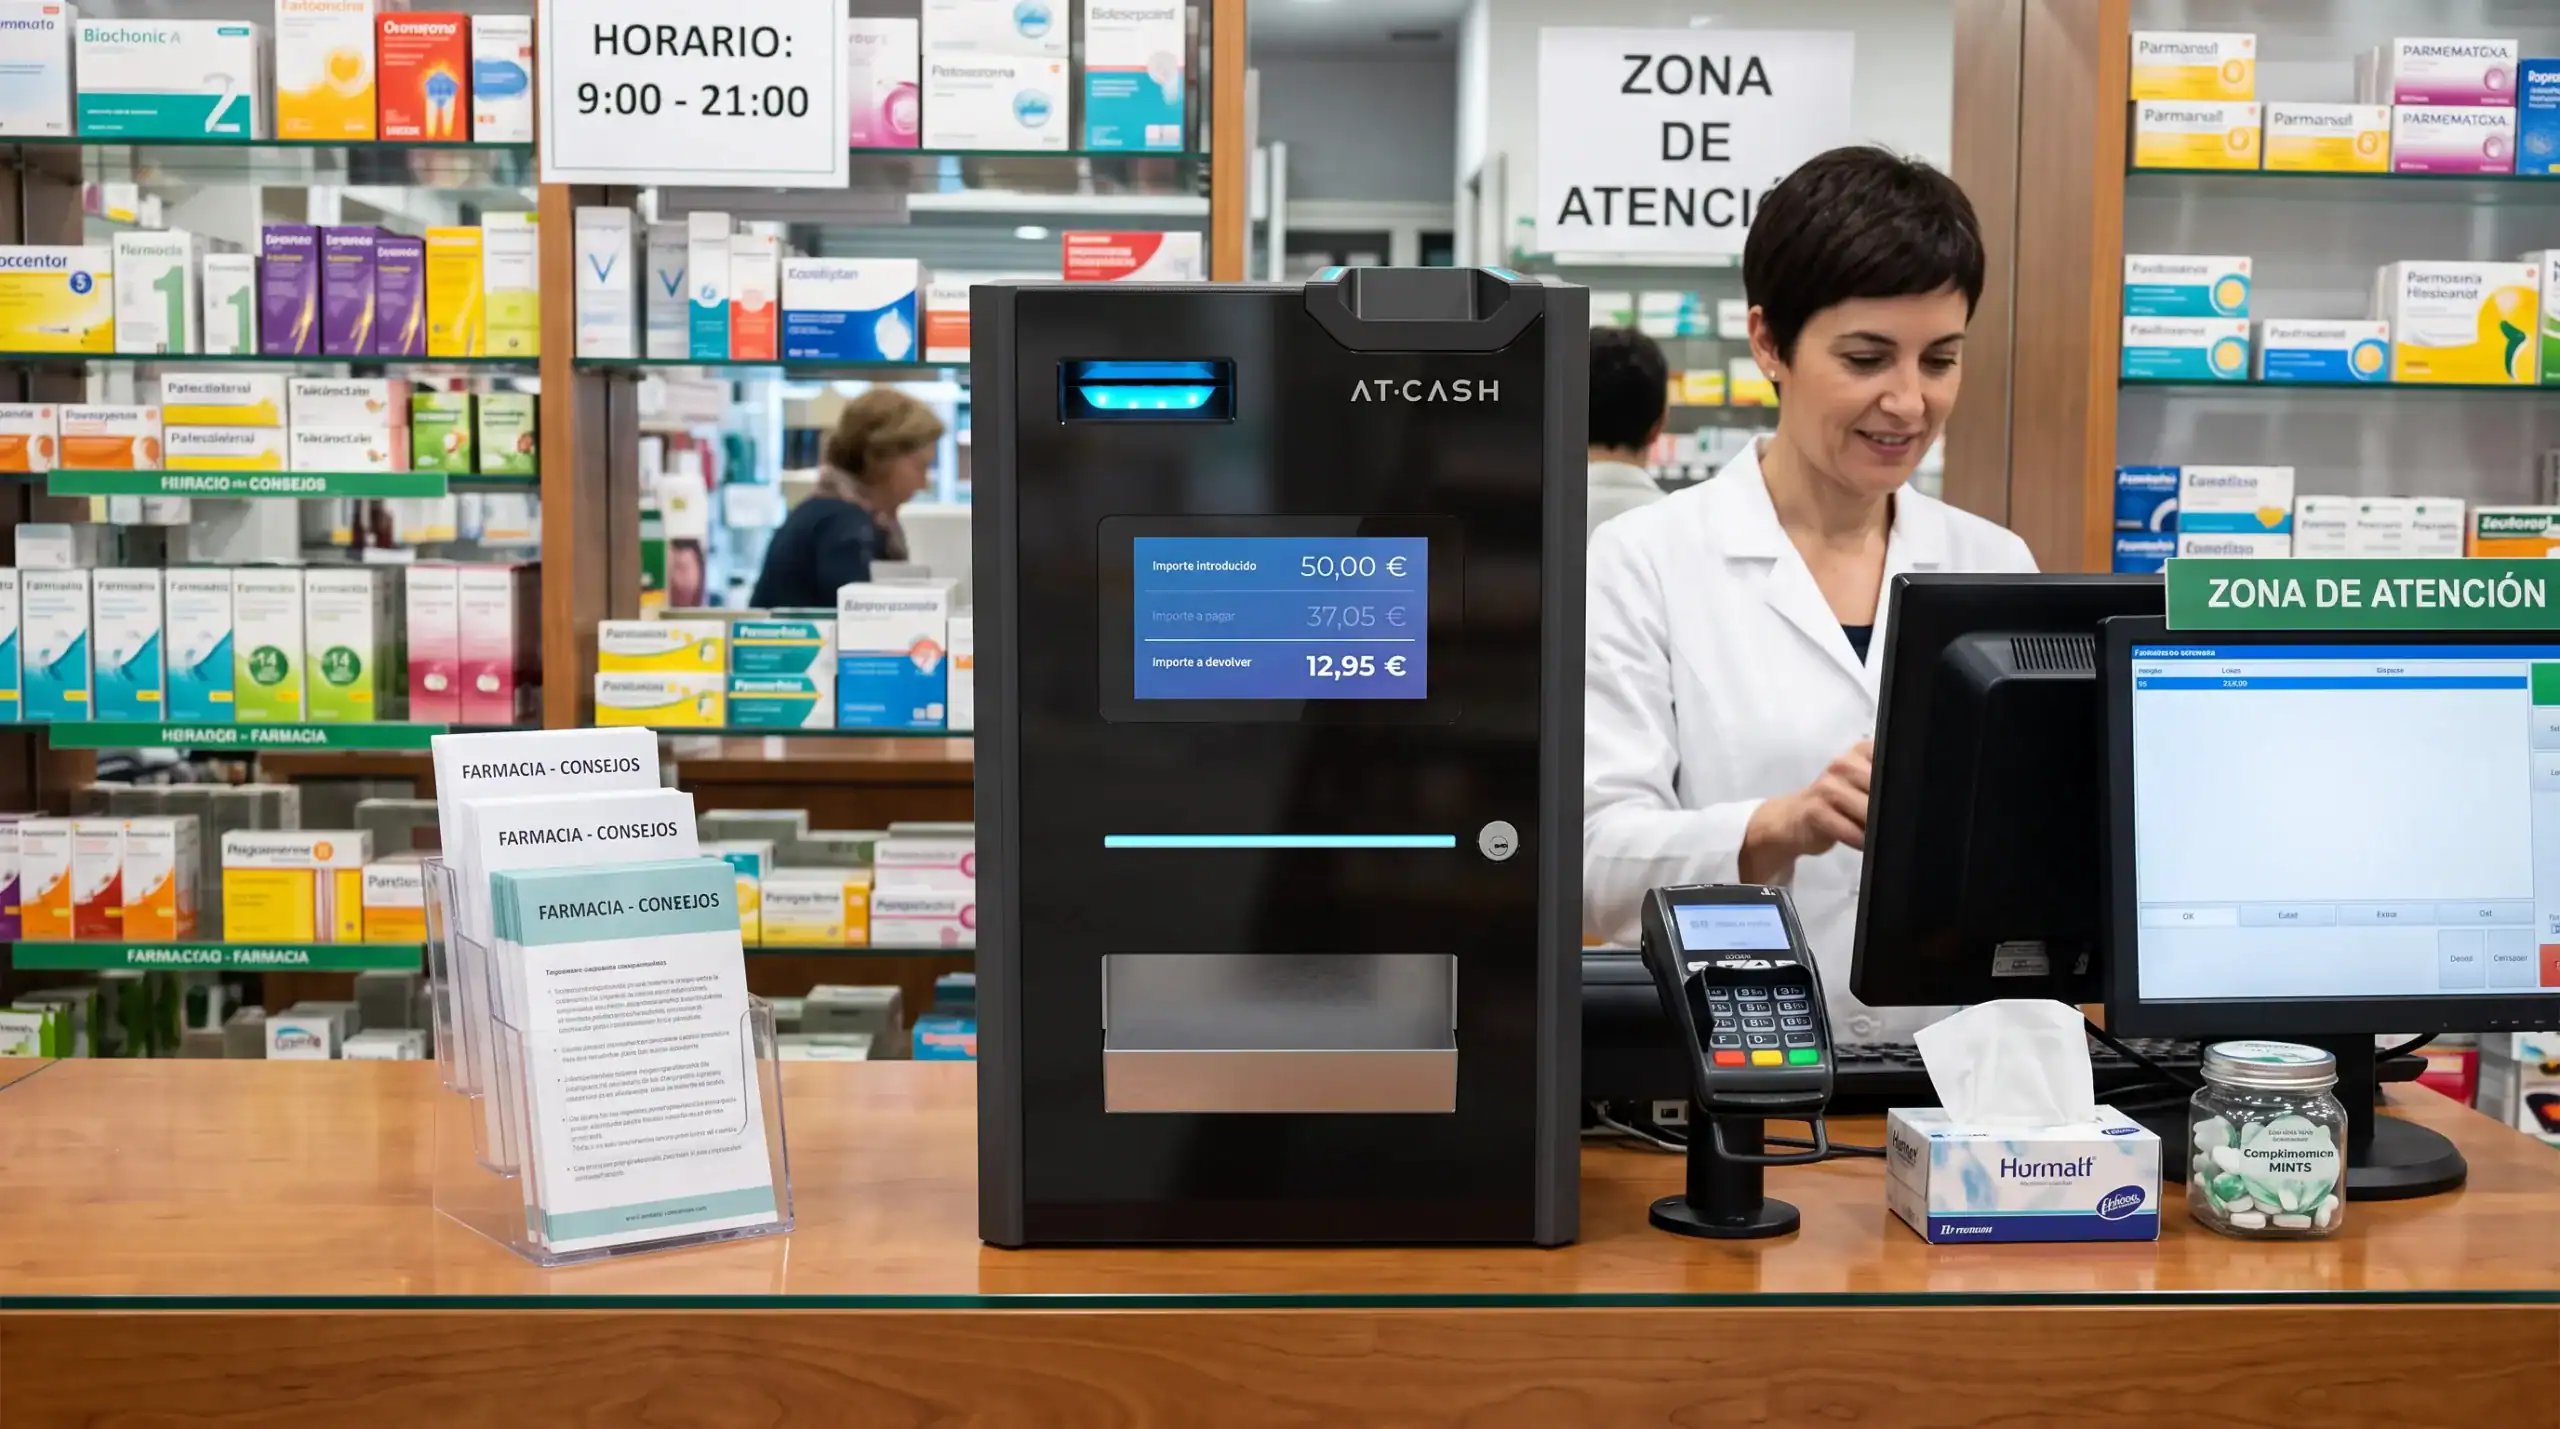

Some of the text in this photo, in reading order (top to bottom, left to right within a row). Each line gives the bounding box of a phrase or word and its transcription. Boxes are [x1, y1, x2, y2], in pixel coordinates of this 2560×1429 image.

[83, 28, 167, 44] Biochonic
[594, 24, 793, 58] HORARIO:
[1620, 54, 1774, 97] ZONA
[202, 71, 242, 133] 2
[577, 82, 810, 118] 9:00 - 21:00
[1661, 121, 1731, 162] DE
[1556, 185, 1772, 229] ATENCI
[1152, 555, 1408, 582] Importe introducido 50,00 €
[2207, 571, 2546, 609] ZONA DE ATENCIÓN
[1152, 605, 1407, 632] Importe a pagar 37,05 €
[1152, 654, 1407, 681] Importe a devolver 12,95 €
[250, 728, 328, 744] FARMACIA
[462, 762, 546, 779] FARMACIA
[560, 757, 641, 776] CONSEJOS
[499, 828, 583, 847] FARMACIA
[597, 822, 678, 841] CONSEJOS
[539, 900, 624, 920] FARMACIA
[233, 949, 310, 965] FARMACIA
[2269, 1162, 2312, 1173] MINTS
